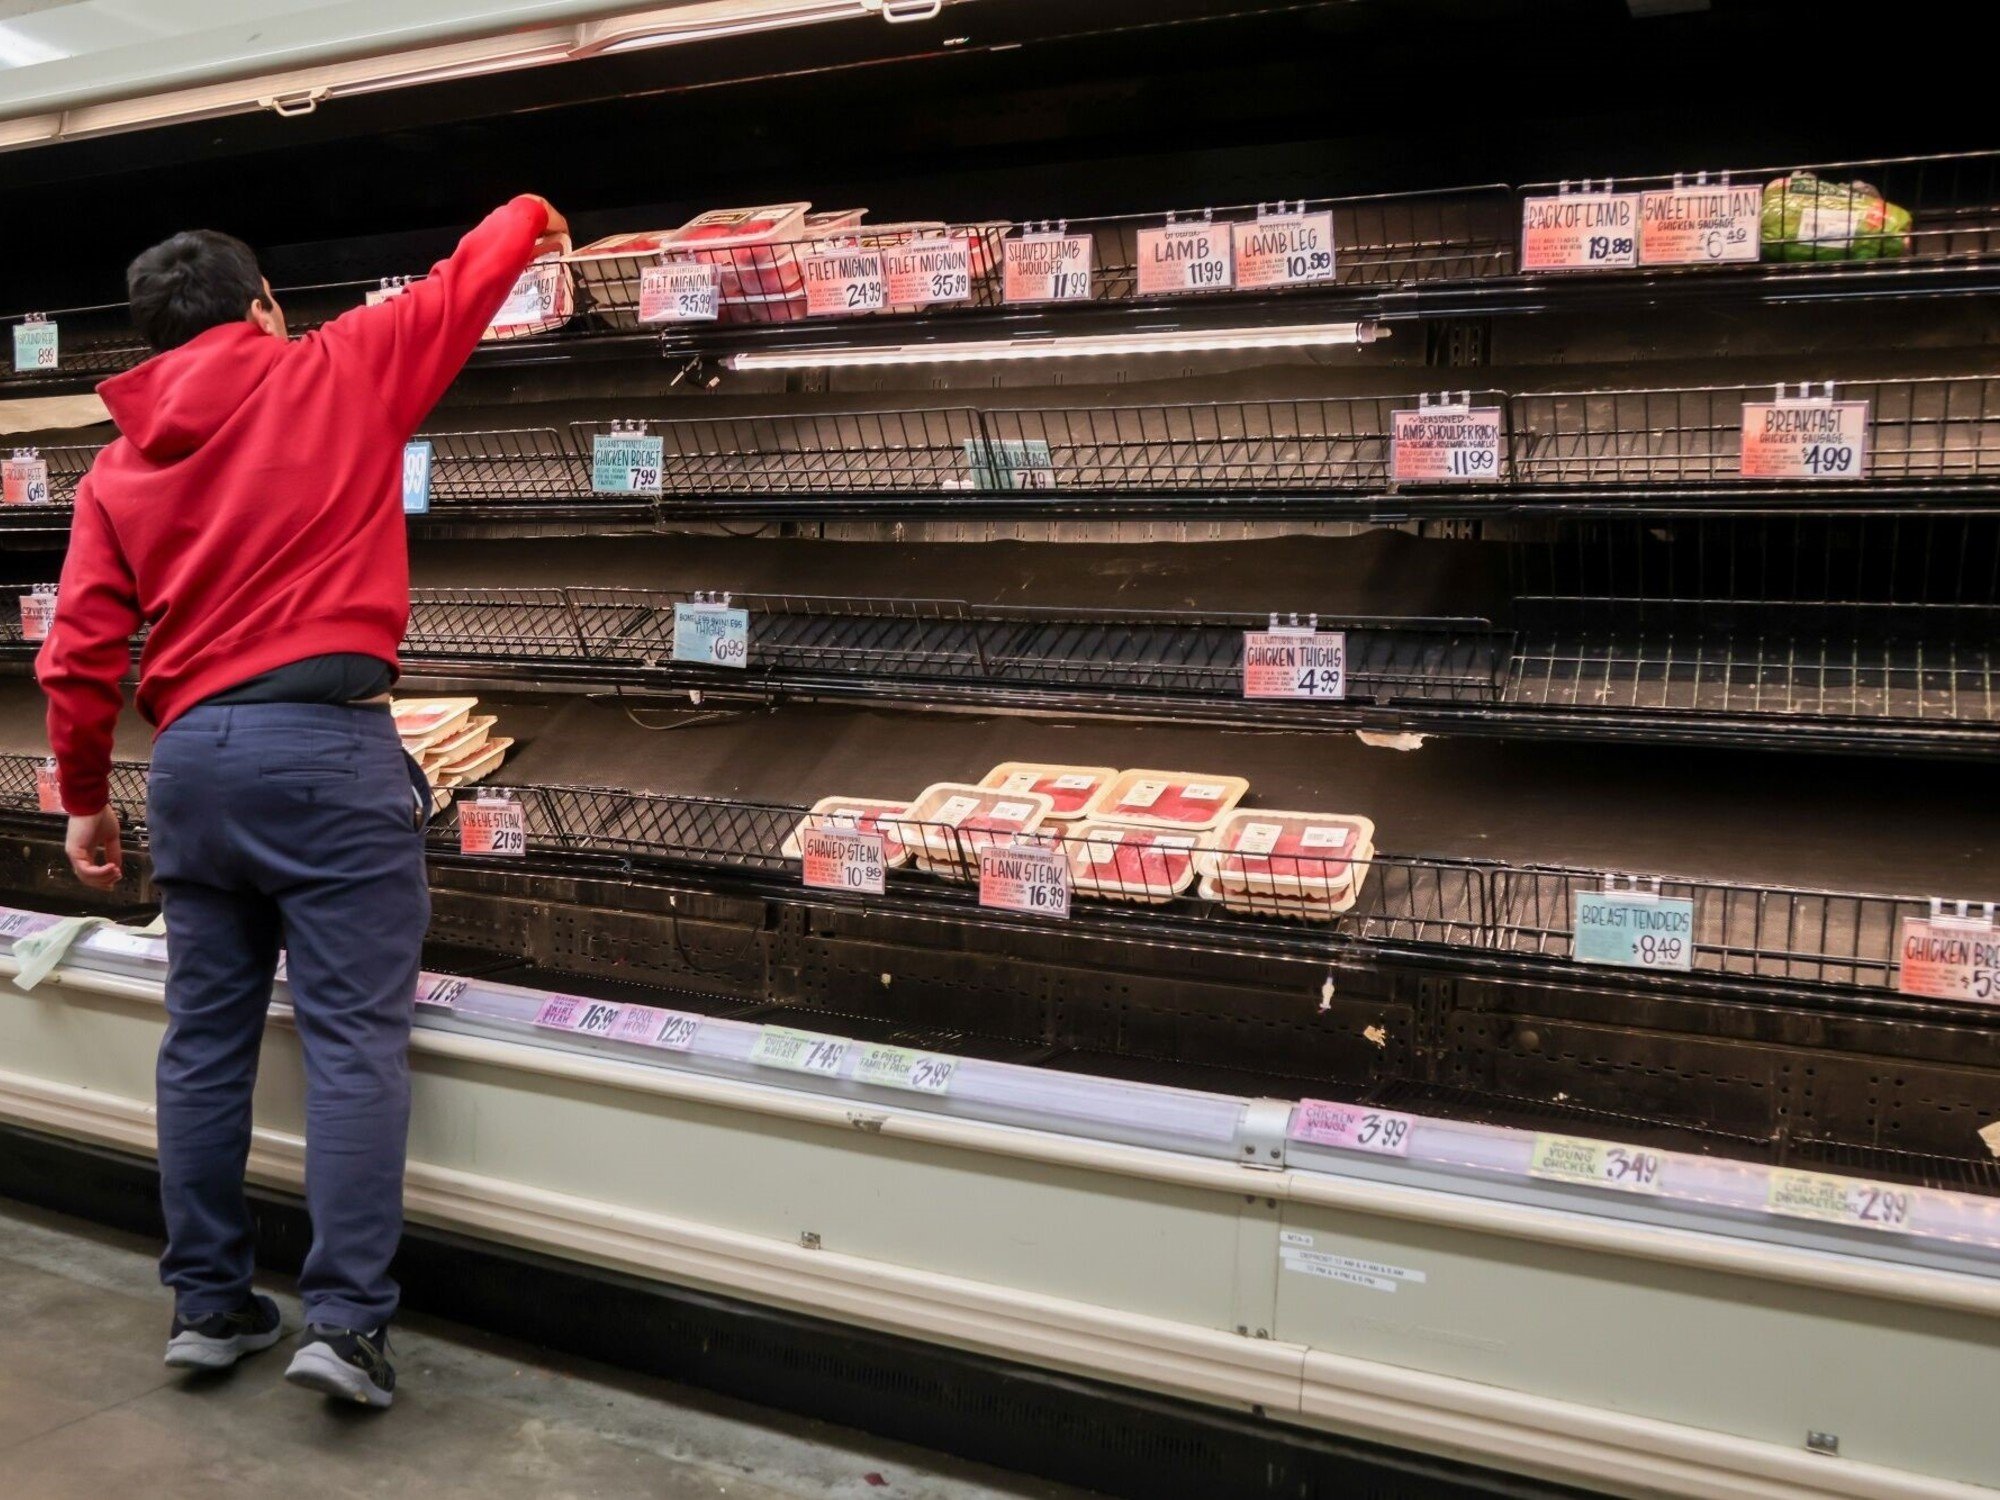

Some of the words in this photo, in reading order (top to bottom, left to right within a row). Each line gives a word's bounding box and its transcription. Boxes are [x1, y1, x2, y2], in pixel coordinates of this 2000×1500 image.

[1529, 204, 1562, 230] RACK
[1565, 203, 1582, 228] OF
[1585, 201, 1630, 227] LAMB
[1646, 195, 1692, 221] SWEET
[1698, 191, 1756, 221] ITALIAN
[1657, 220, 1696, 232] CHICKEN
[1697, 217, 1736, 231] SAUSAGE
[1008, 242, 1048, 262] SHAVED
[1050, 240, 1080, 260] LAMB
[1154, 237, 1210, 263] LAMB
[1244, 230, 1287, 258] LAMB
[1289, 228, 1318, 252] LEG
[807, 258, 837, 282] FILET
[838, 256, 878, 279] MIGNON
[888, 252, 917, 275] FILET
[920, 248, 967, 272] MIGNON
[1017, 260, 1064, 276] SHOULDER
[1286, 251, 1331, 278] 10.99
[669, 273, 710, 293] MIGNON
[1418, 414, 1465, 424] SEASONED
[1765, 408, 1844, 433] BREAKFAST
[1396, 424, 1426, 441] LAMB
[1427, 424, 1474, 441] SHOULDER
[1474, 424, 1500, 441] RACK
[1759, 433, 1798, 444] CHICKEN
[1801, 433, 1844, 444] SAUSAGE
[595, 448, 629, 467] CHICKEN
[630, 449, 661, 468] BREAST
[695, 623, 727, 637] THIGHS
[1247, 646, 1296, 667] CHICKEN
[1298, 647, 1342, 668] THIGHS
[493, 812, 520, 829] STEAK
[807, 838, 846, 860] SHAVED
[847, 843, 880, 864] STEAK
[983, 857, 1022, 882] FLANK
[1024, 862, 1064, 886] STEAK
[1582, 904, 1629, 928] BREAST
[1631, 908, 1691, 933] TENDERS
[1905, 935, 1971, 967] CHICKEN
[859, 1057, 888, 1071] FAMILY
[889, 1062, 911, 1074] PACK
[882, 1051, 904, 1061] PIECE
[1305, 1108, 1355, 1124] CHICKEN
[1308, 1120, 1348, 1133] WINGS
[1549, 1147, 1593, 1162] YOUNG
[1542, 1157, 1597, 1174] CHICKEN
